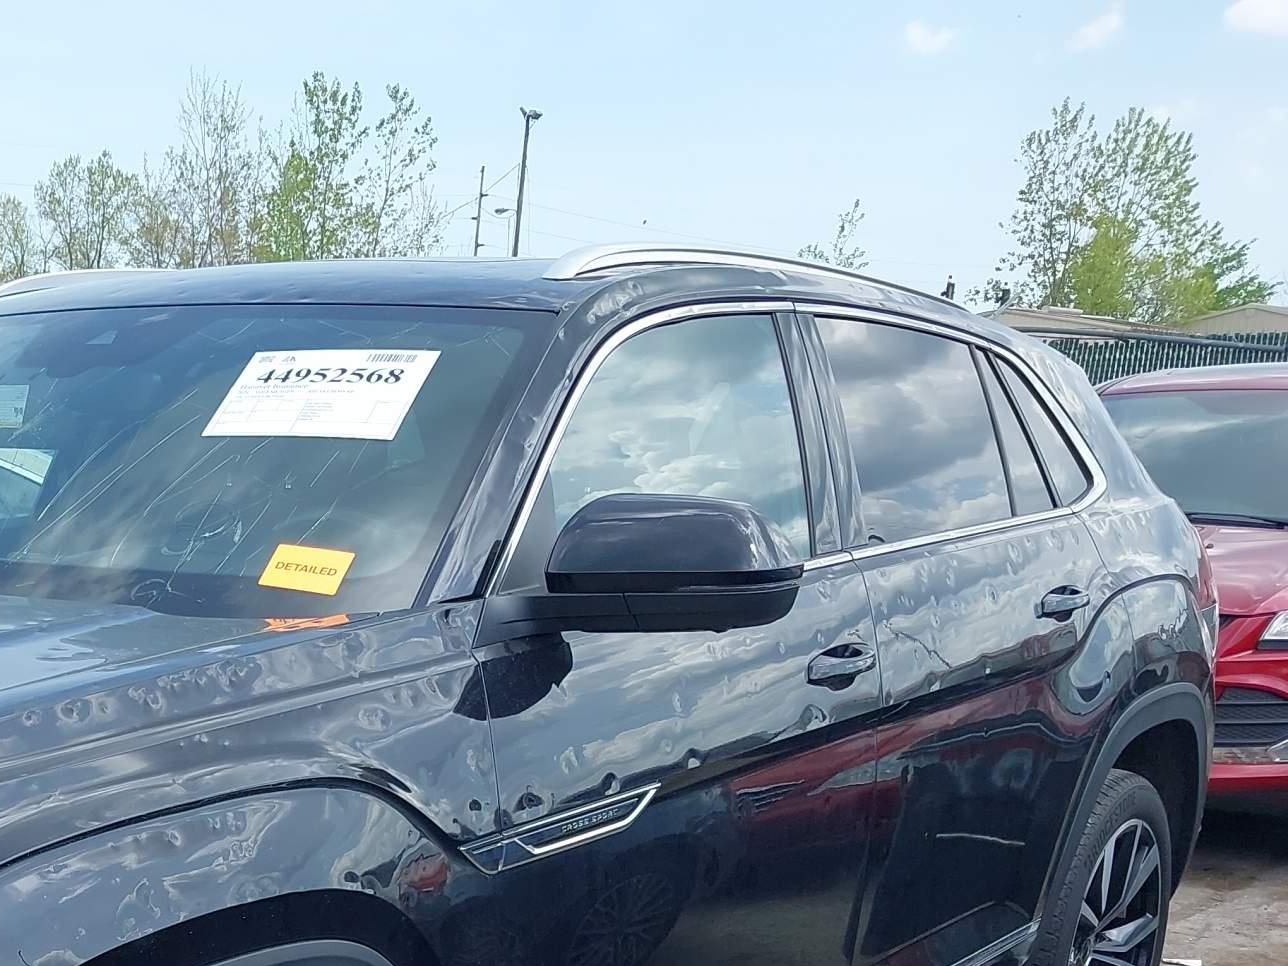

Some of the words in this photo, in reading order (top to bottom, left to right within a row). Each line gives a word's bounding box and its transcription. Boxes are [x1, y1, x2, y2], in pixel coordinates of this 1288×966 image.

[257, 367, 404, 384] 44952568
[275, 561, 337, 577] DETAILED
[561, 818, 589, 833] CROSS
[591, 808, 619, 823] SPORT
